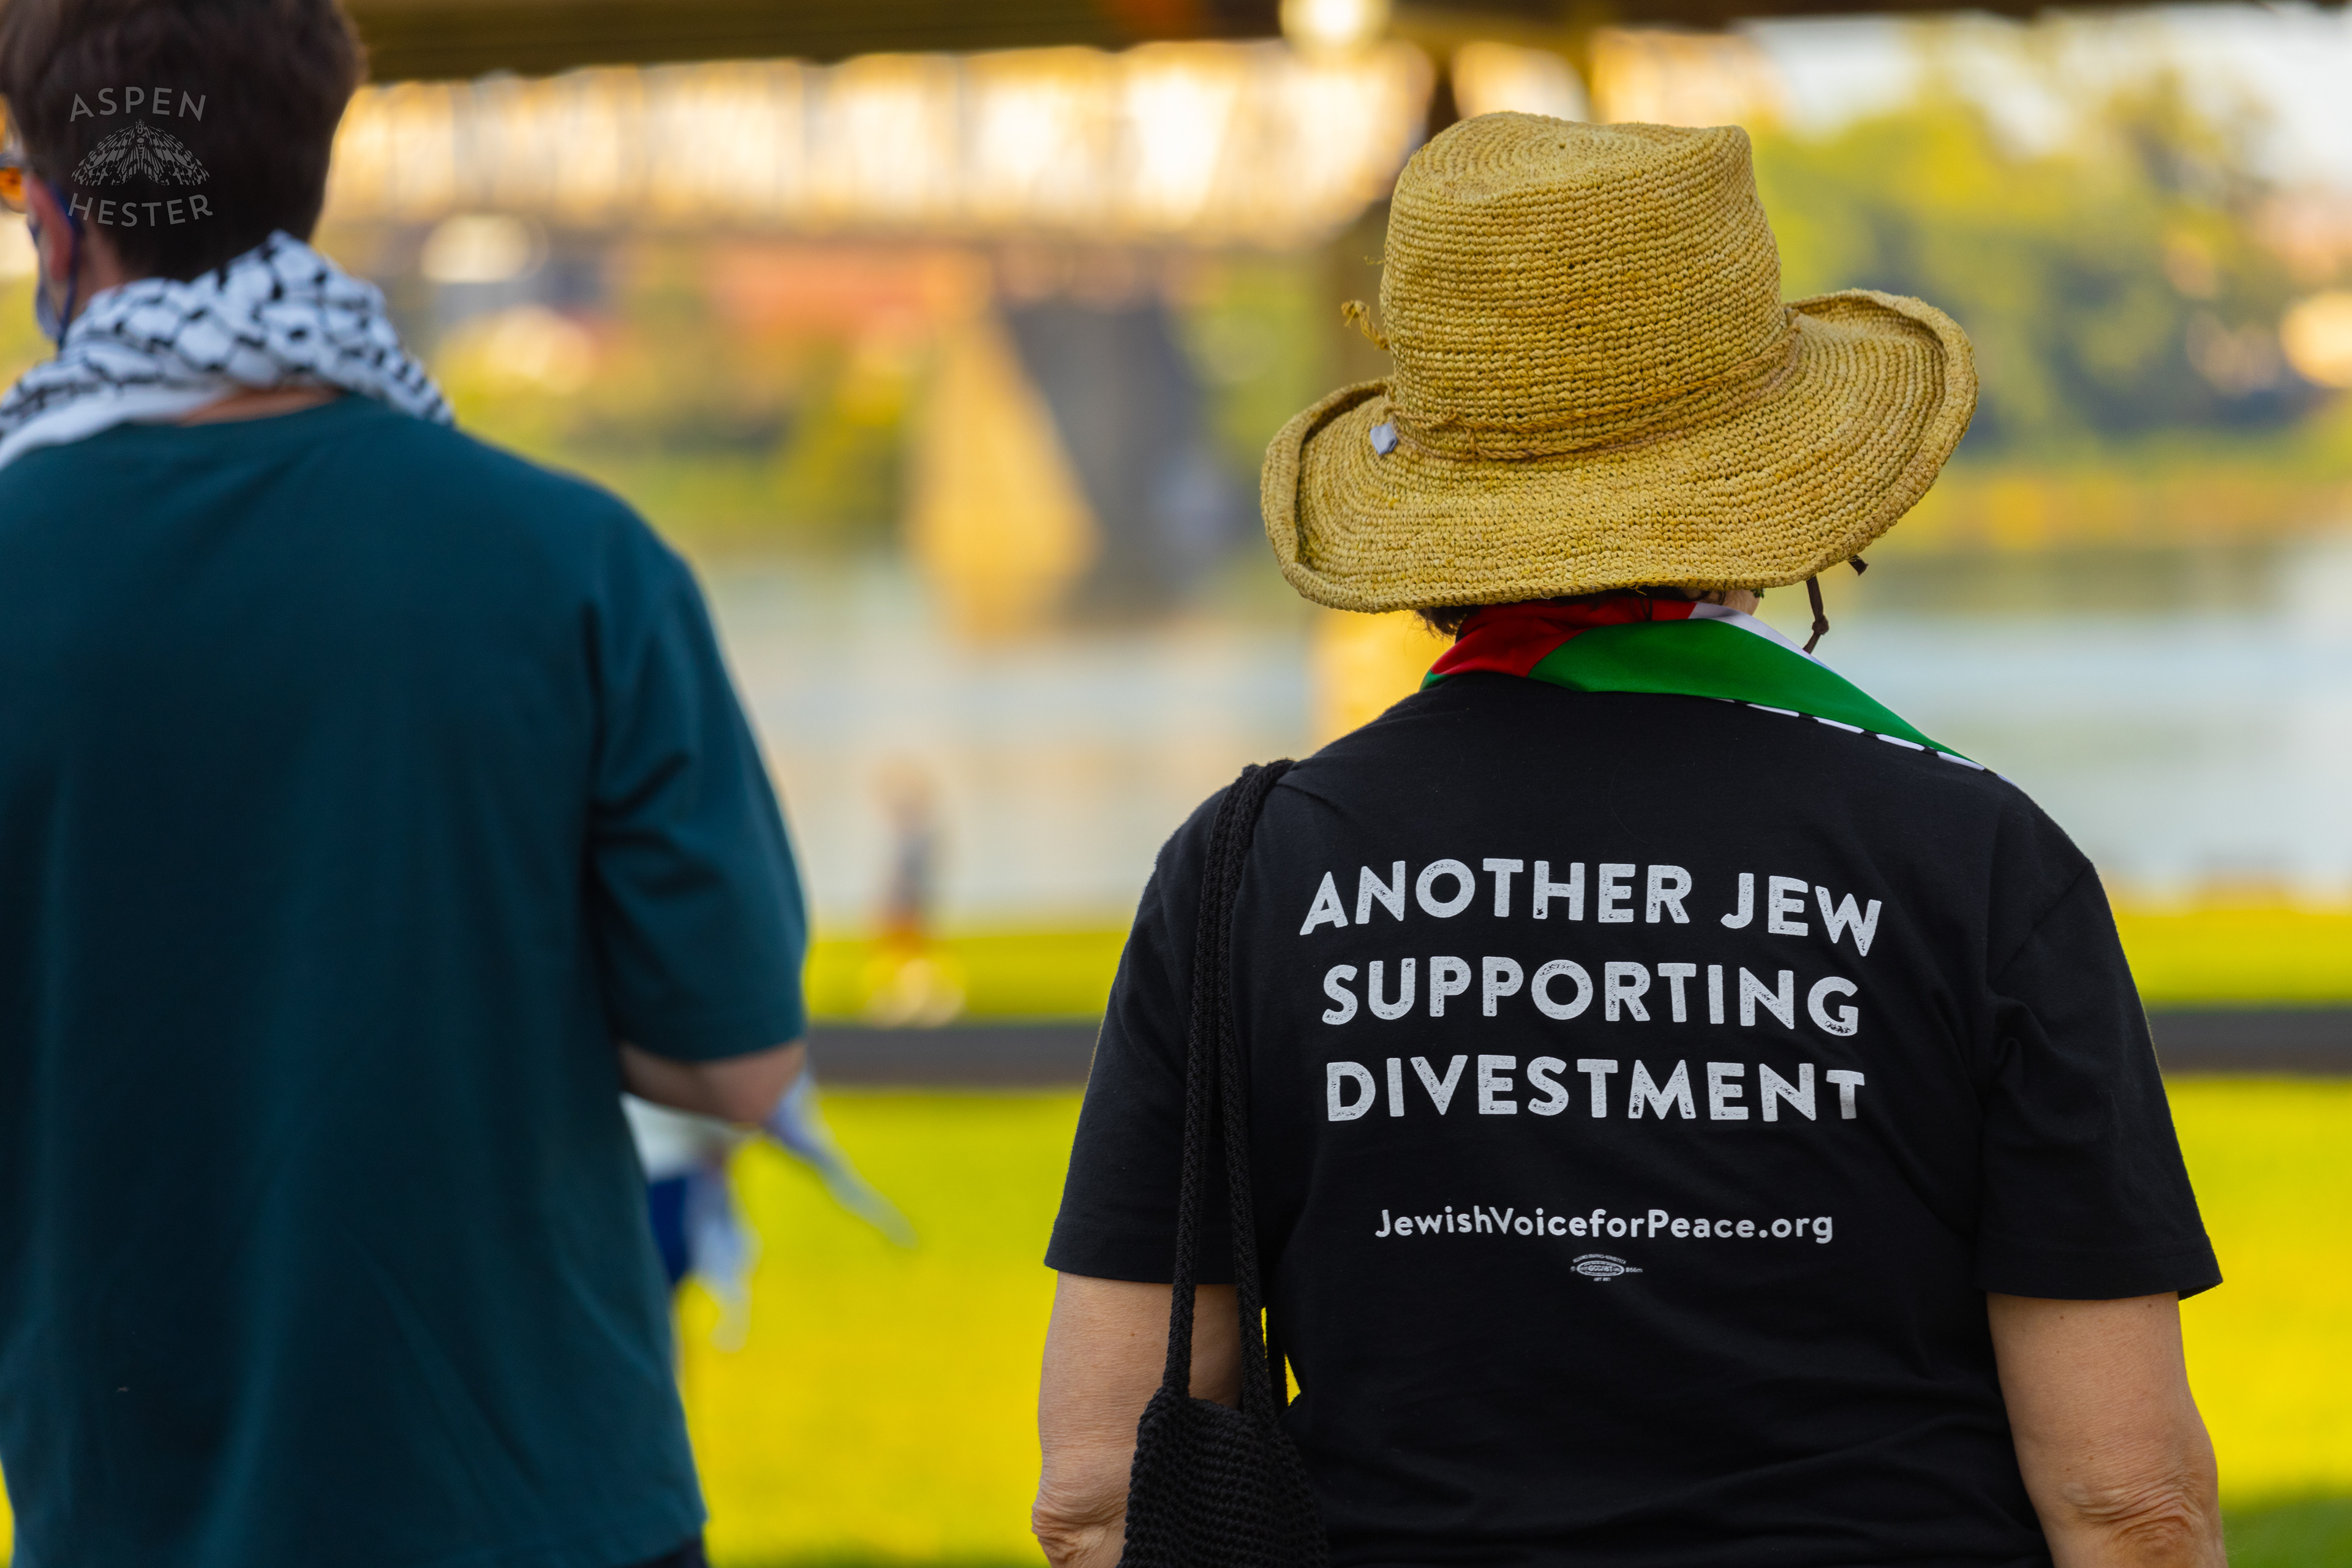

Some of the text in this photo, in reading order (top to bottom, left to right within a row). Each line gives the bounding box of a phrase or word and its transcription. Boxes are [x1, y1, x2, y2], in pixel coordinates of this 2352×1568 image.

[1299, 858, 1882, 957] ANOTHER JEW
[1322, 956, 1859, 1036] SUPPORTING
[1326, 1054, 1865, 1122] DIVESTMENT
[1374, 1205, 1833, 1244] JewishVoiceforPeace.org
